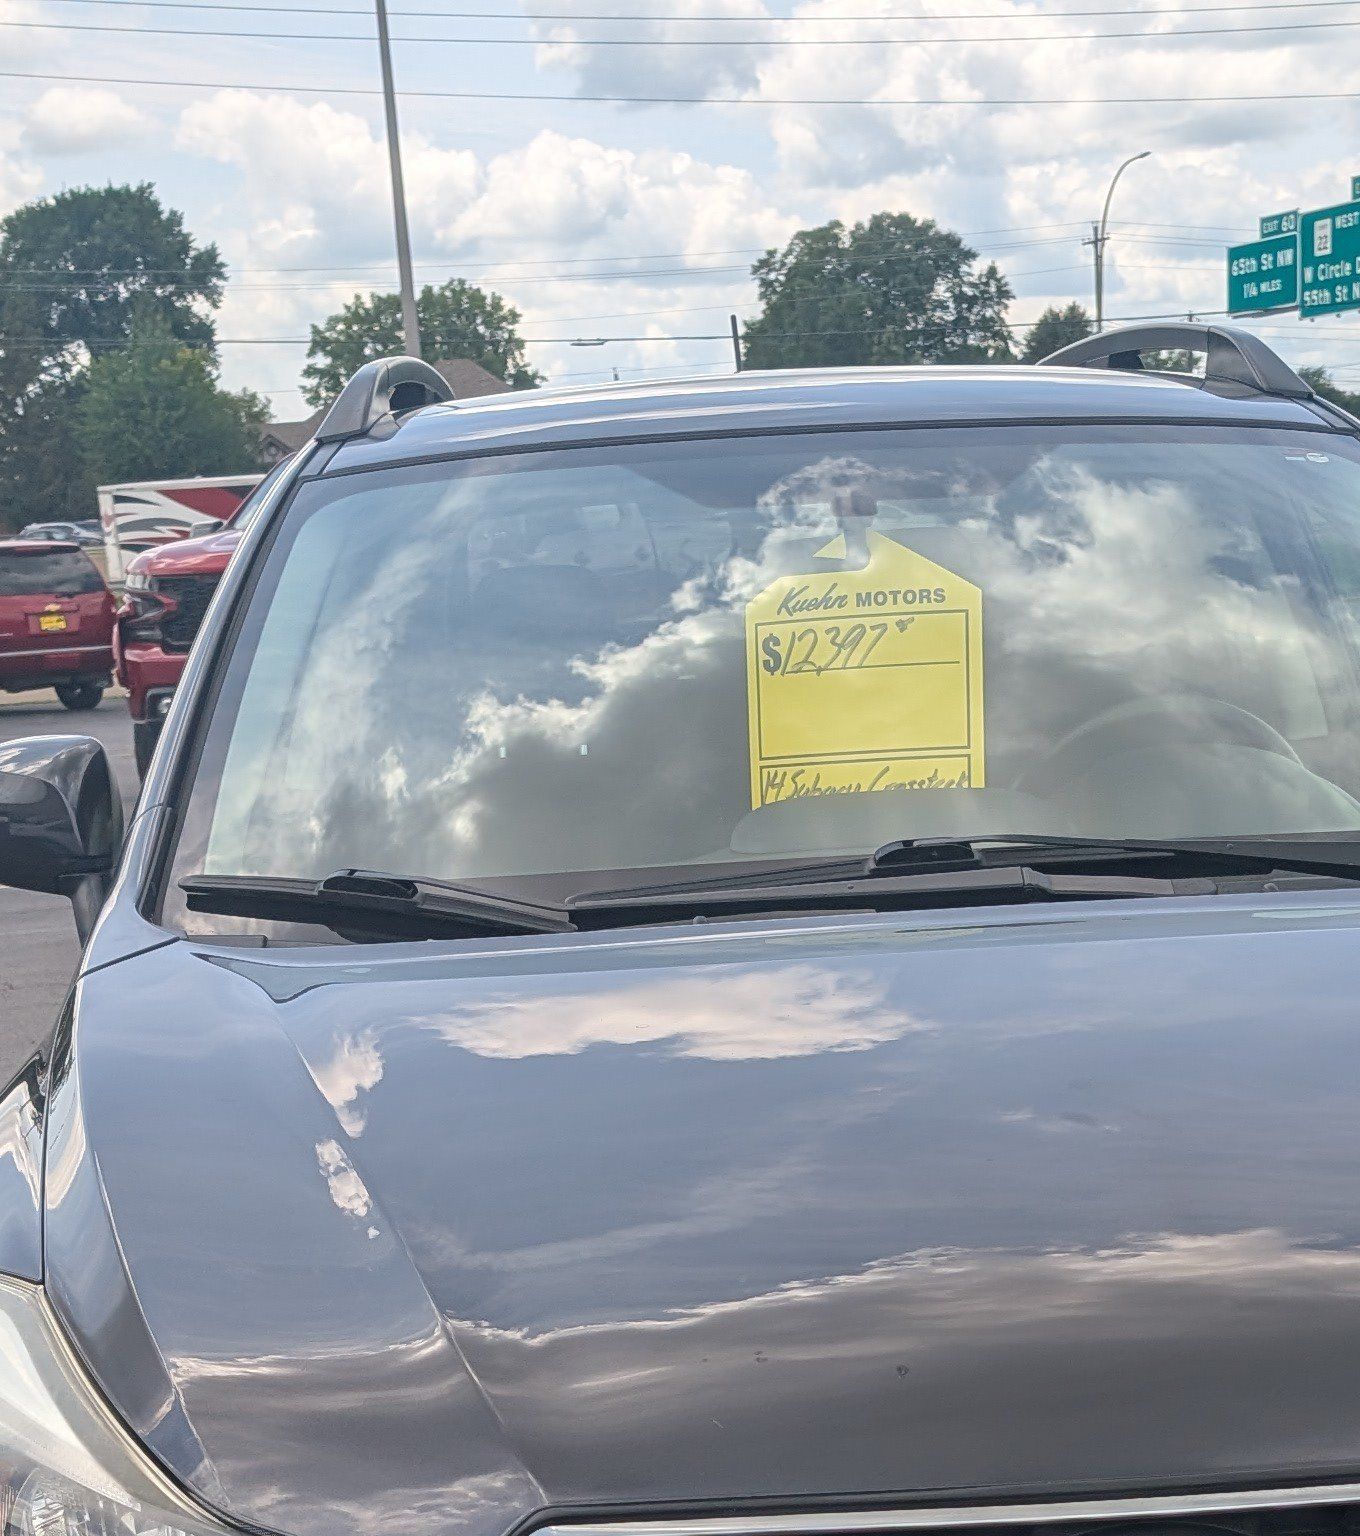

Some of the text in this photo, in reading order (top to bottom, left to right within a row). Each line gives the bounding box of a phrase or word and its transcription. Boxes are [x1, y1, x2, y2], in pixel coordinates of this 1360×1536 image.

[1262, 214, 1296, 234] EXIT 60
[1334, 211, 1360, 229] WEST
[1231, 248, 1295, 277] 65th St NW
[1303, 266, 1314, 284] W
[1317, 259, 1352, 281] Circle
[1303, 288, 1332, 307] 55th
[1334, 284, 1348, 302] St
[776, 582, 946, 617] Kuehn MOTORS
